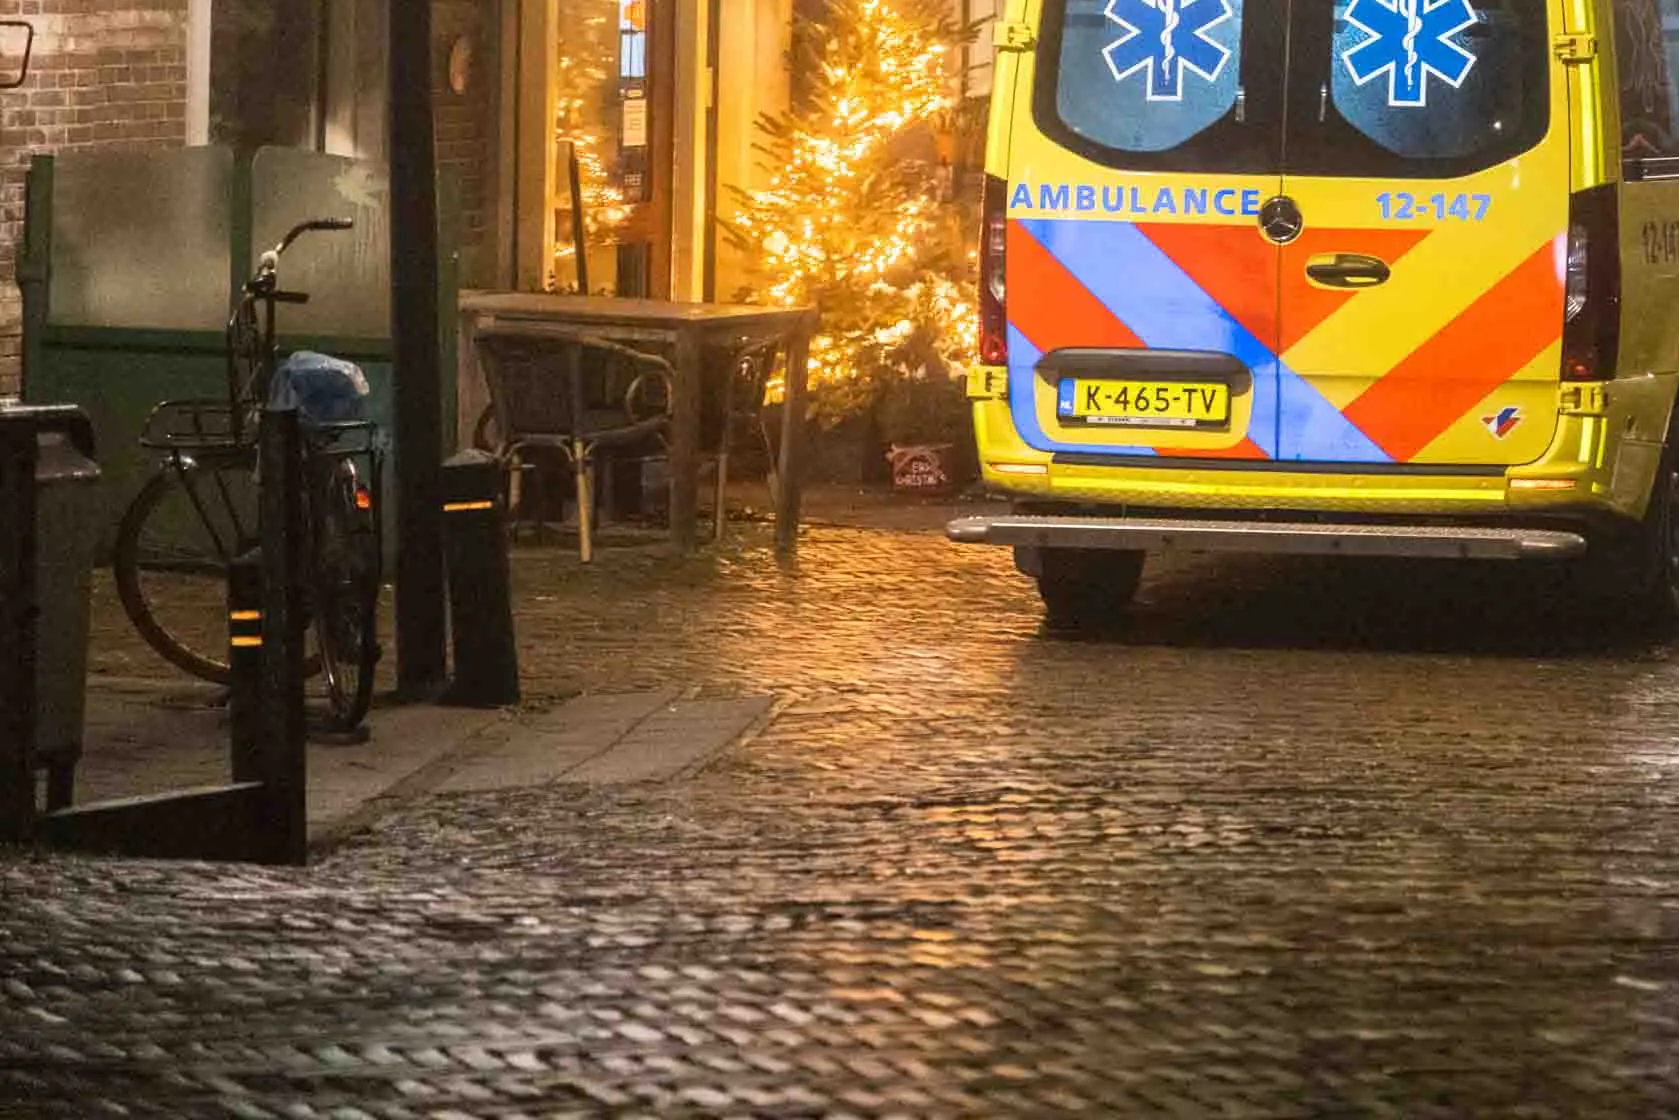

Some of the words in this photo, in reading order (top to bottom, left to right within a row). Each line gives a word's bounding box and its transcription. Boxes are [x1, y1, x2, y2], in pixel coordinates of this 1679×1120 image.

[1010, 183, 1261, 216] AMBULANCE
[1376, 192, 1492, 221] 12-147
[1086, 385, 1216, 414] K-465-TV
